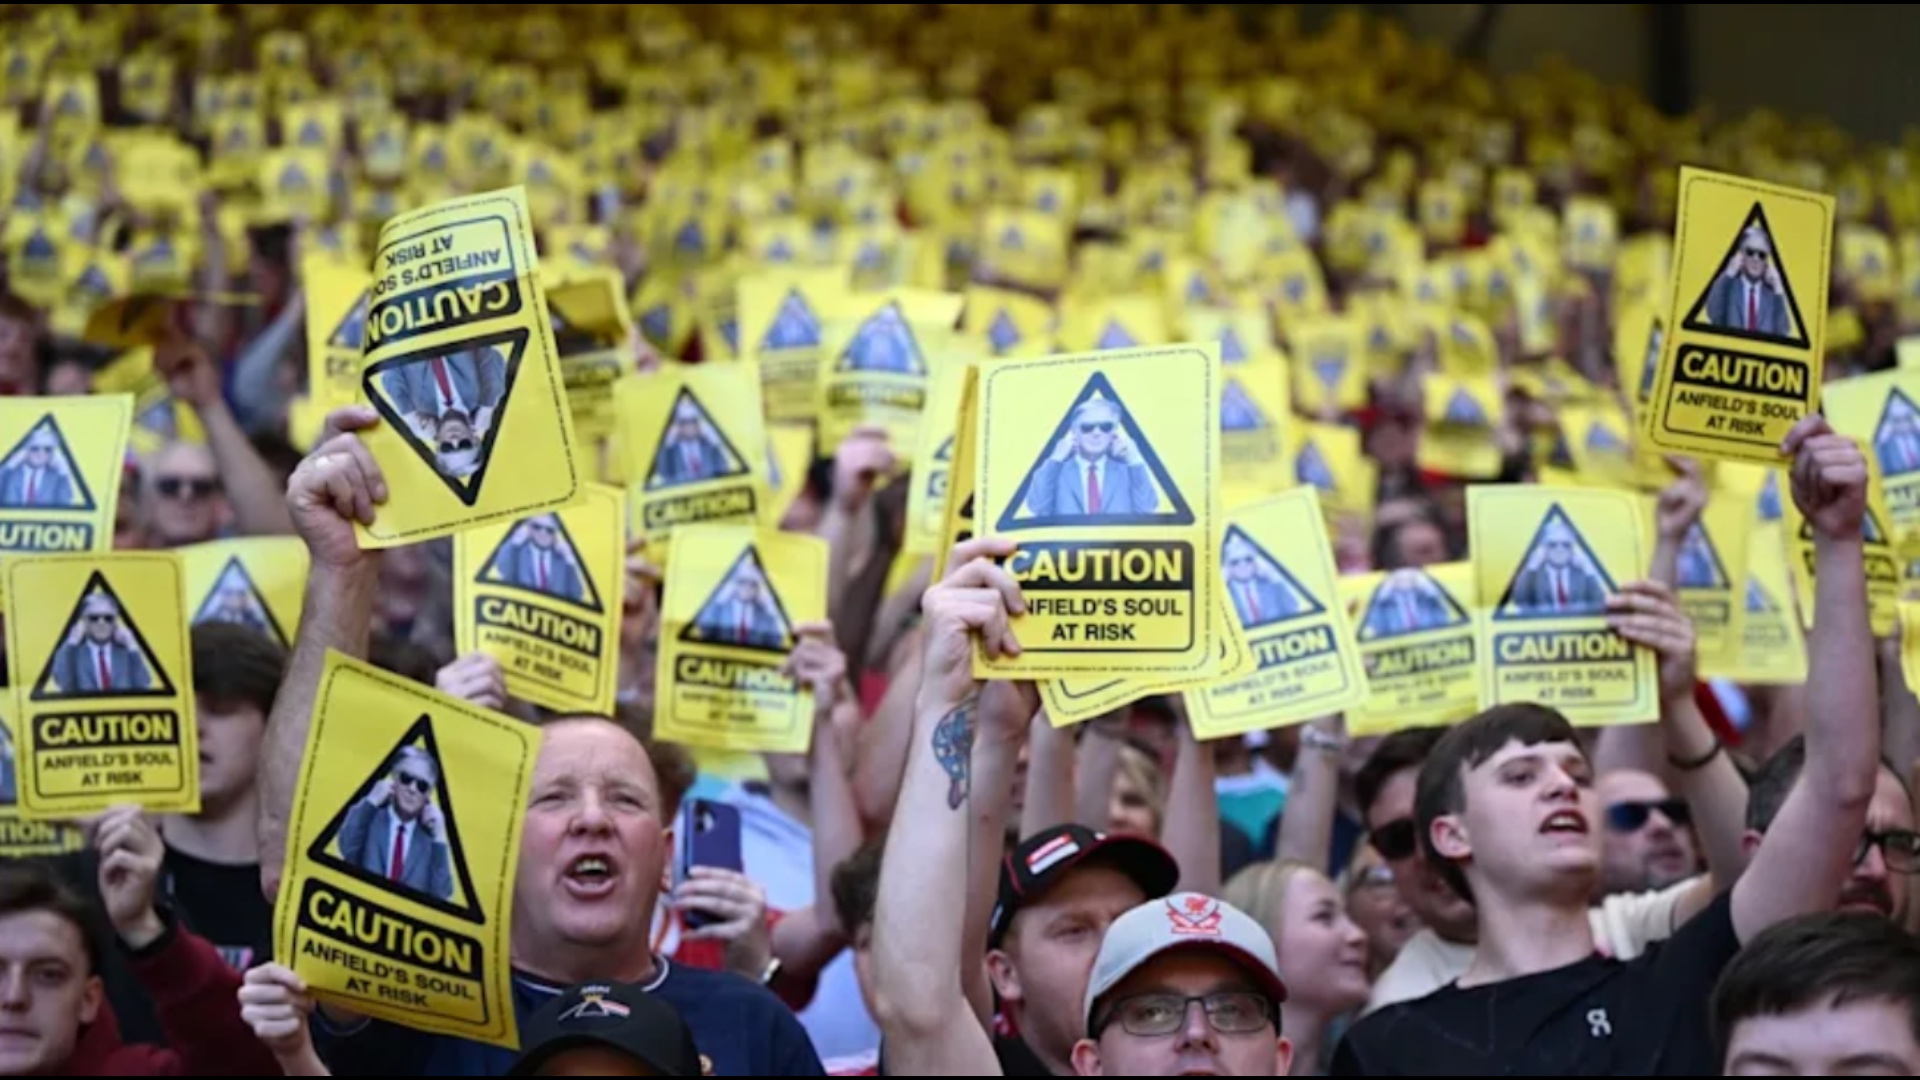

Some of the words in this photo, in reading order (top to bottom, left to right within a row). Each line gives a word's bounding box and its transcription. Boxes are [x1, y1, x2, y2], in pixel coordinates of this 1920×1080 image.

[385, 241, 426, 268] RISK
[431, 233, 455, 254] AT
[402, 248, 501, 286] ANFIELD'S
[375, 274, 398, 295] SO
[367, 280, 510, 345] CAUTION
[1682, 350, 1803, 395] CAUTION
[1676, 390, 1757, 415] ANFIELD'S
[1762, 400, 1801, 421] SOUL
[1706, 415, 1727, 431] AT
[1729, 417, 1766, 436] RISK
[0, 524, 86, 548] UTION
[1004, 549, 1183, 583] CAUTION
[1024, 598, 1118, 616] NFIELD'S
[1123, 598, 1183, 616] SOUL
[481, 599, 597, 650] CAUTION
[1051, 624, 1080, 641] AT
[1085, 624, 1136, 641] RISK
[1257, 628, 1329, 664] TION
[1501, 634, 1628, 661] CAUTION
[40, 714, 173, 745] CAUTION
[44, 753, 128, 770] ANFIELD'S
[81, 772, 100, 787] AT
[106, 771, 144, 785] RISK
[308, 890, 472, 973] CAUTION
[303, 938, 410, 983] ANFIELD'S
[415, 972, 476, 1001] SOUL
[345, 977, 374, 995] AT
[377, 982, 430, 1008] RISK
